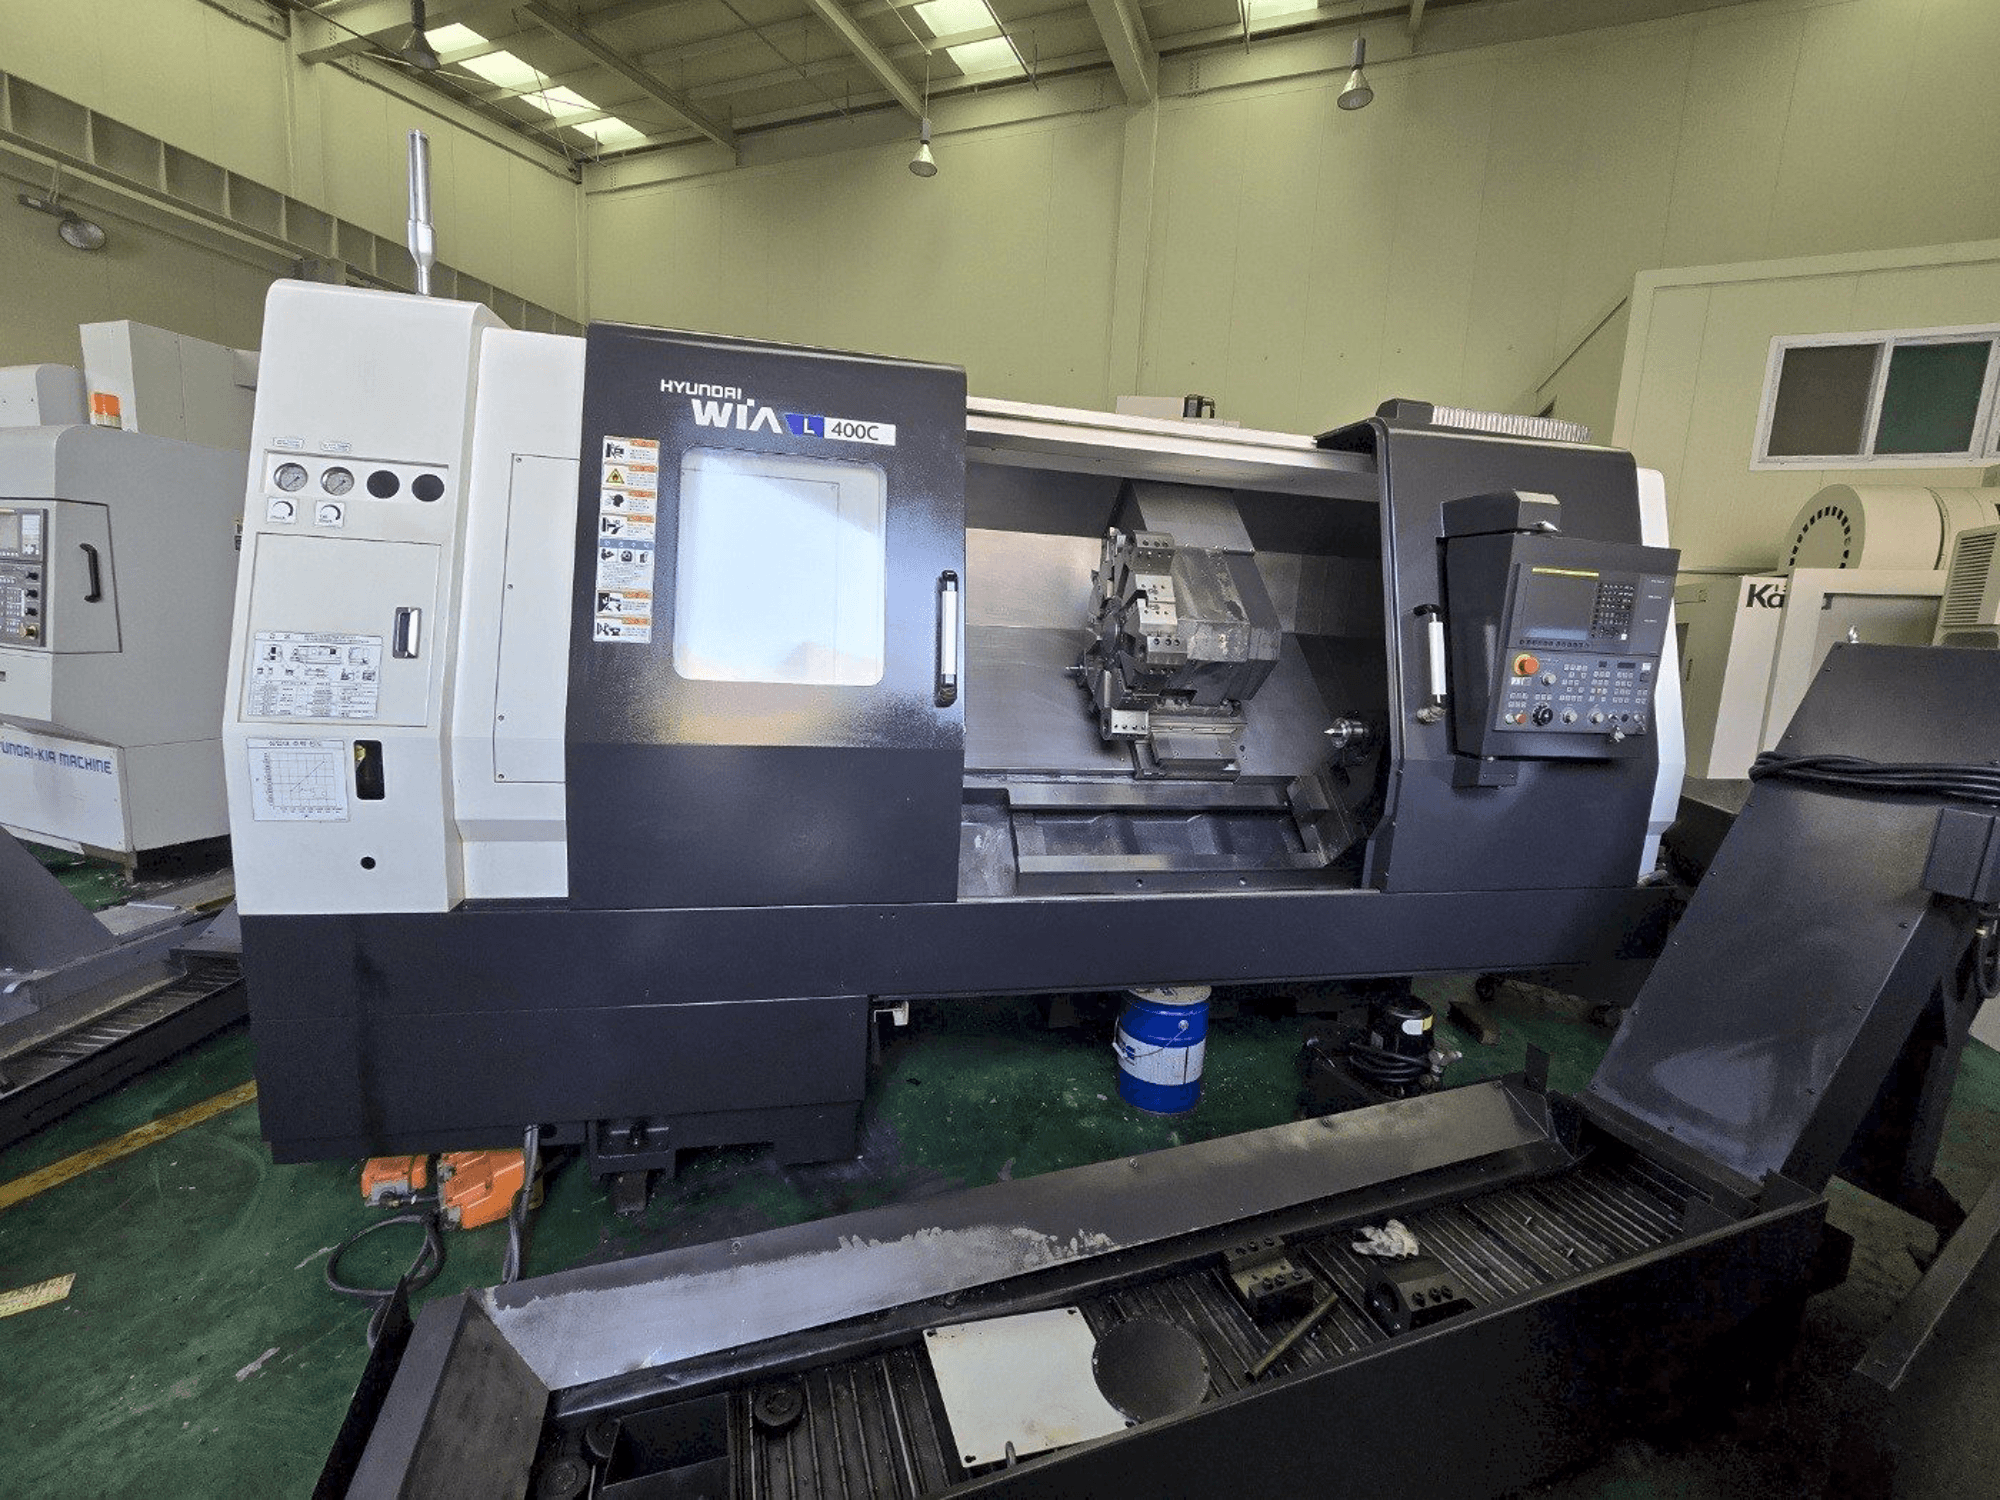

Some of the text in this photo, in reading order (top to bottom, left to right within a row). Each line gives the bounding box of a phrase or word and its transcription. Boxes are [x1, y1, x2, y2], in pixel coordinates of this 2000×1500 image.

[660, 379, 742, 400] HYUNDAI
[803, 417, 880, 442] L 400C
[59, 752, 112, 775] MACHINE
